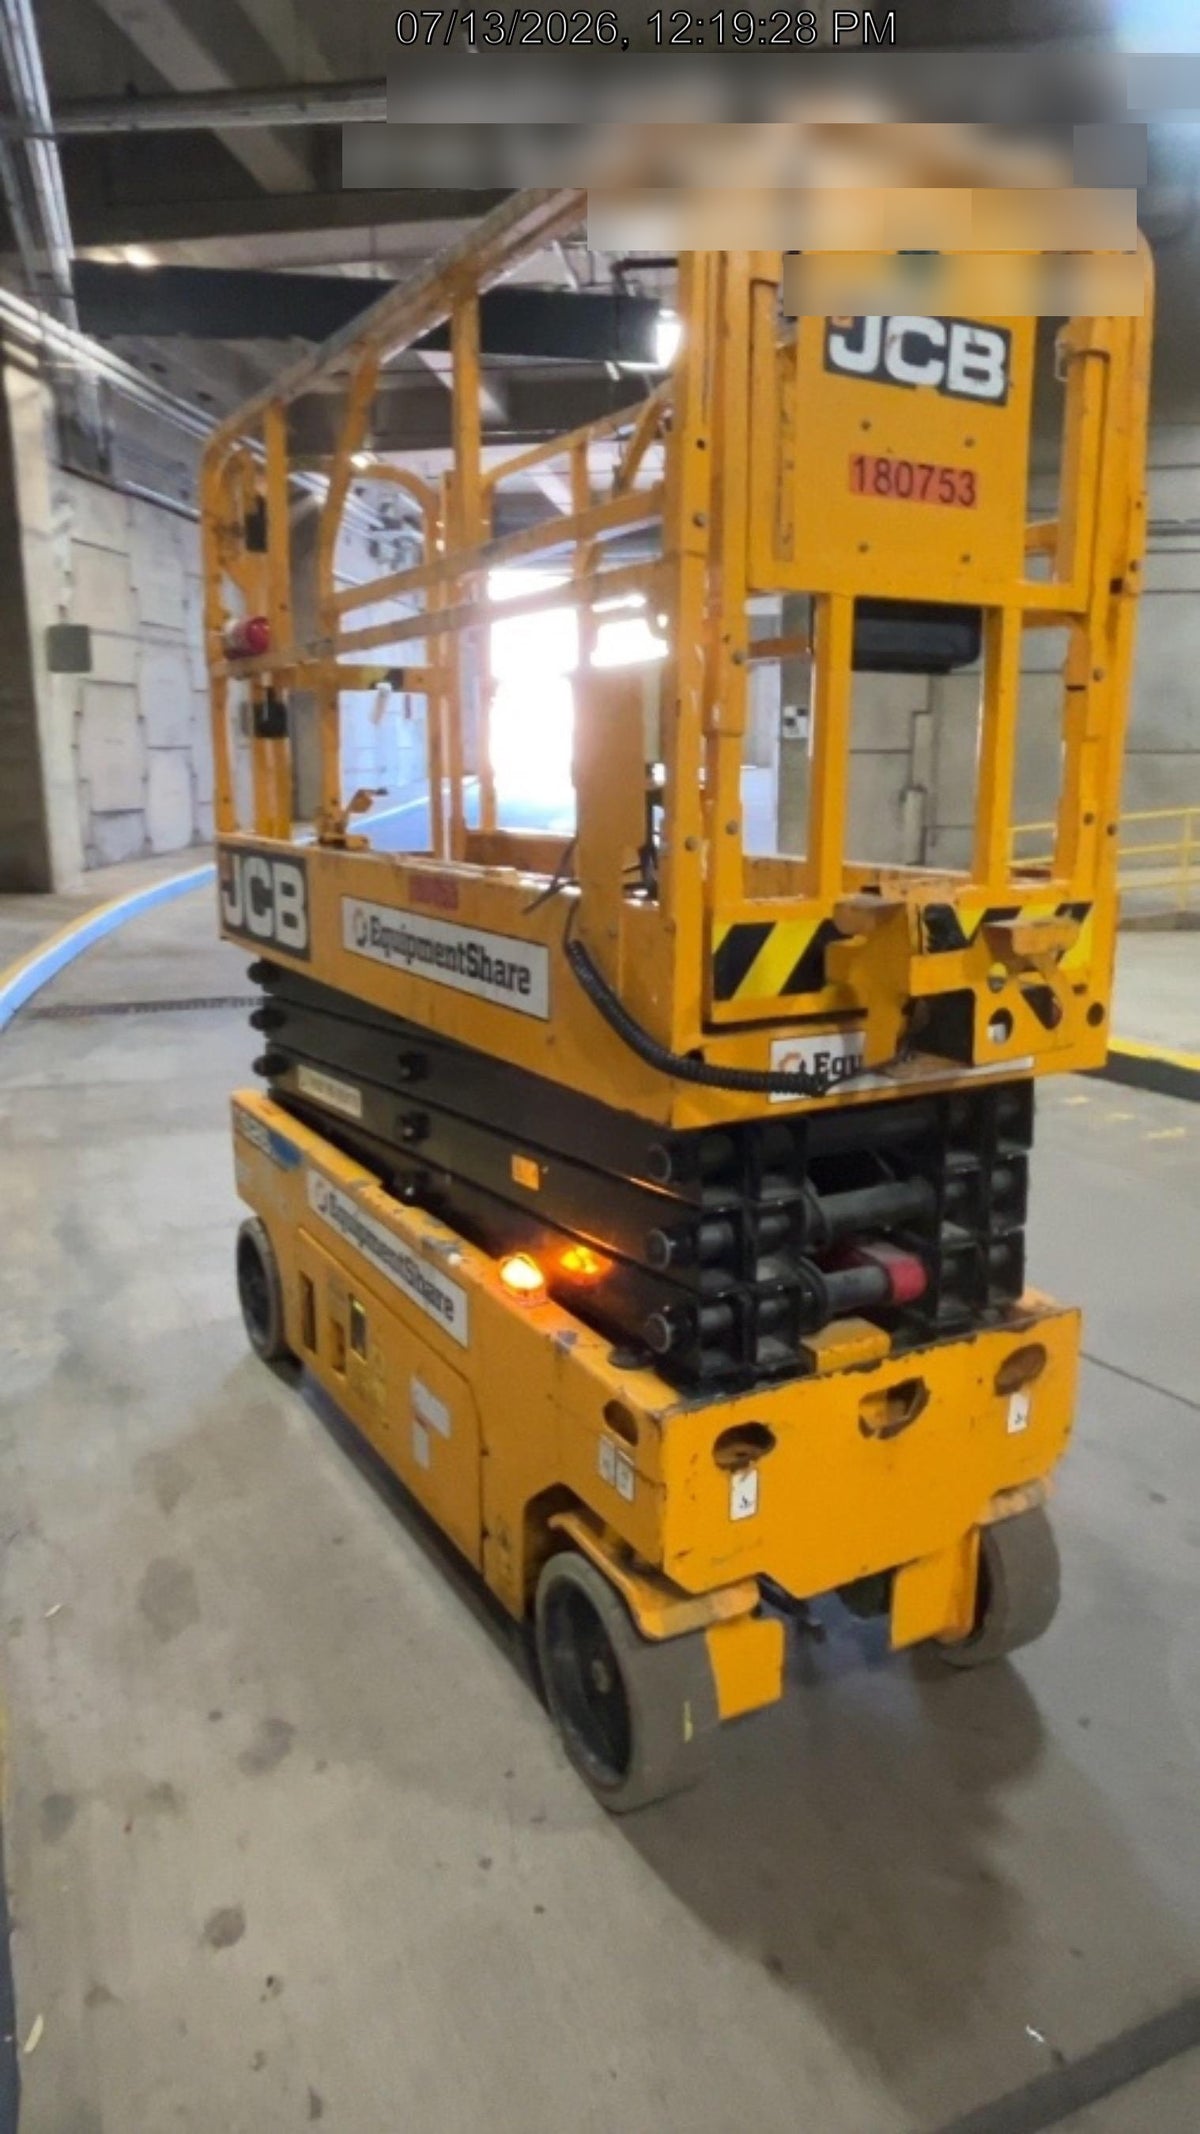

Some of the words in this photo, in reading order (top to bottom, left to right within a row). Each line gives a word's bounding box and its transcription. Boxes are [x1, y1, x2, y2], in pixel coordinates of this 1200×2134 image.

[828, 316, 1007, 399] JCB
[853, 455, 976, 507] 180753
[221, 852, 308, 950] JCB
[369, 915, 531, 996] EquipmentShare
